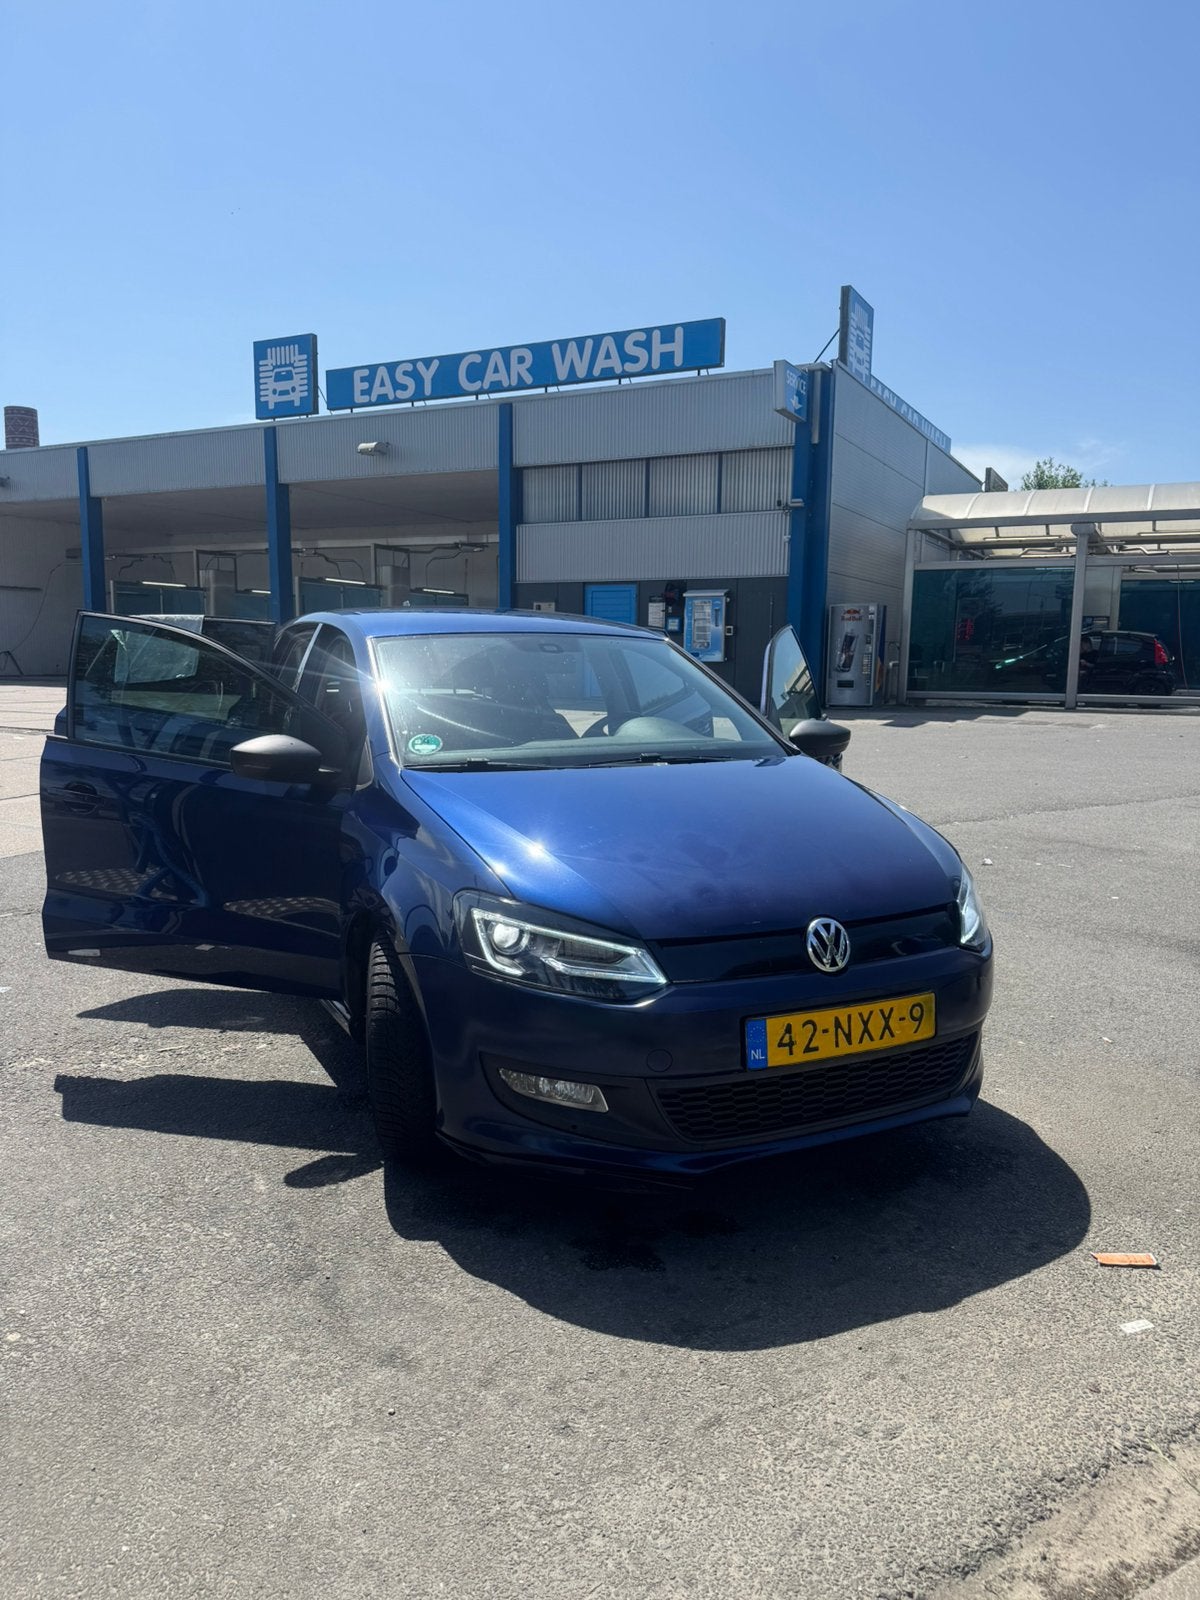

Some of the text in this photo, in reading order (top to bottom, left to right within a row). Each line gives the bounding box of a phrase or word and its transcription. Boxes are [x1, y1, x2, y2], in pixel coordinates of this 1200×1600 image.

[353, 326, 684, 403] EASY CAR WASH
[751, 1049, 765, 1060] NL
[777, 1002, 925, 1056] 42-NXX-9
